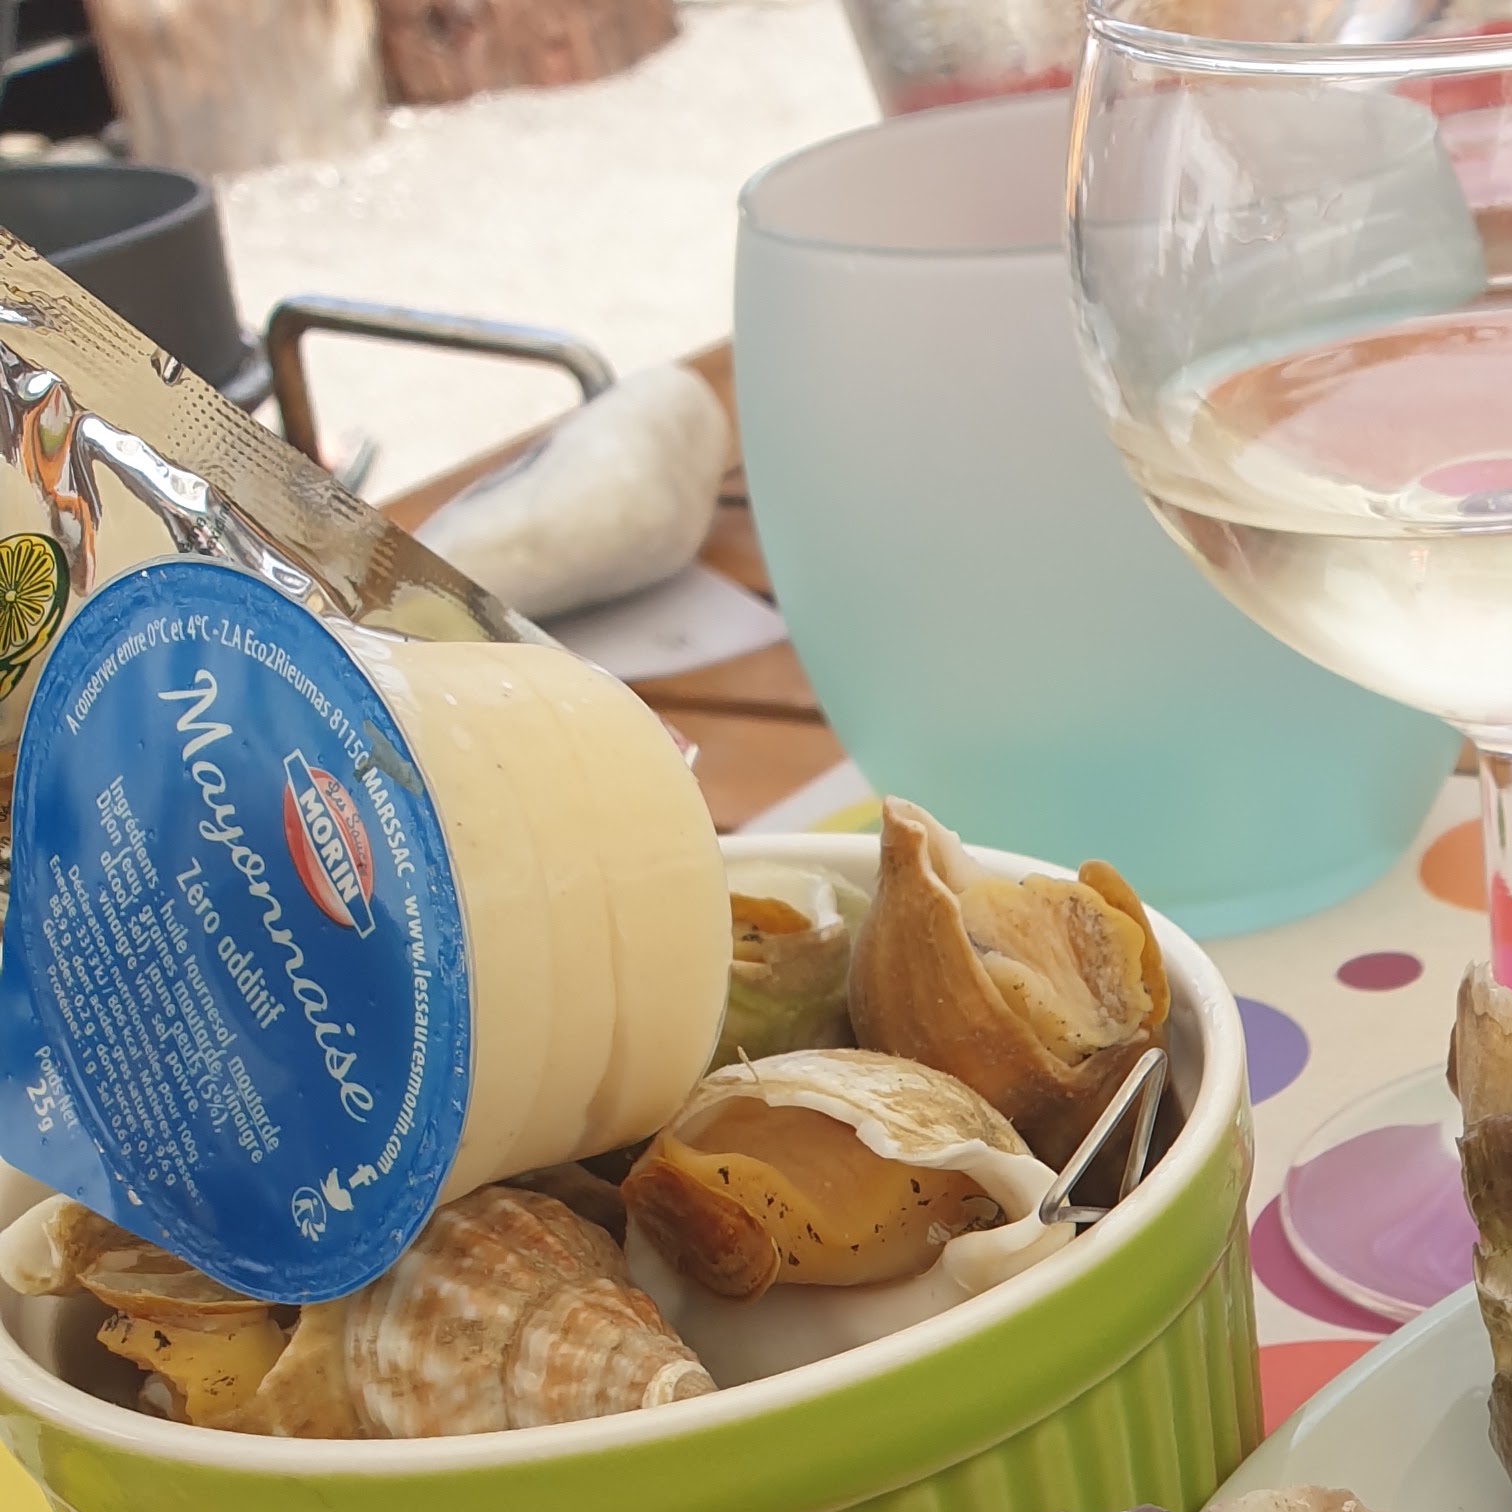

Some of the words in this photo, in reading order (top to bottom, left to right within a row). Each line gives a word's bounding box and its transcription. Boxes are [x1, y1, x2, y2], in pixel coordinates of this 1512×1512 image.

[117, 633, 148, 665] entre
[170, 620, 186, 641] et
[74, 657, 119, 722] conserver
[65, 713, 81, 736] A
[329, 708, 370, 770] 81150
[299, 787, 360, 903] MORIN
[362, 766, 415, 878] MARSSAC
[157, 669, 374, 1123] Mayonnaise
[99, 889, 137, 970] vinaigre
[176, 857, 220, 934] Zéro
[218, 936, 286, 1029] additif
[96, 789, 122, 847] Dijon
[139, 904, 178, 977] graines
[222, 1083, 263, 1163] vinaigre
[110, 775, 159, 889] Ingrédients
[160, 898, 189, 954] huile
[227, 1055, 281, 1152] moutarde
[145, 959, 176, 1017] jaune
[122, 1026, 142, 1060] kcal
[377, 895, 432, 1175] www.lessaucesmorin.com
[34, 1045, 64, 1096] Poids
[158, 1082, 181, 1119] pour
[26, 1077, 56, 1132] 25g
